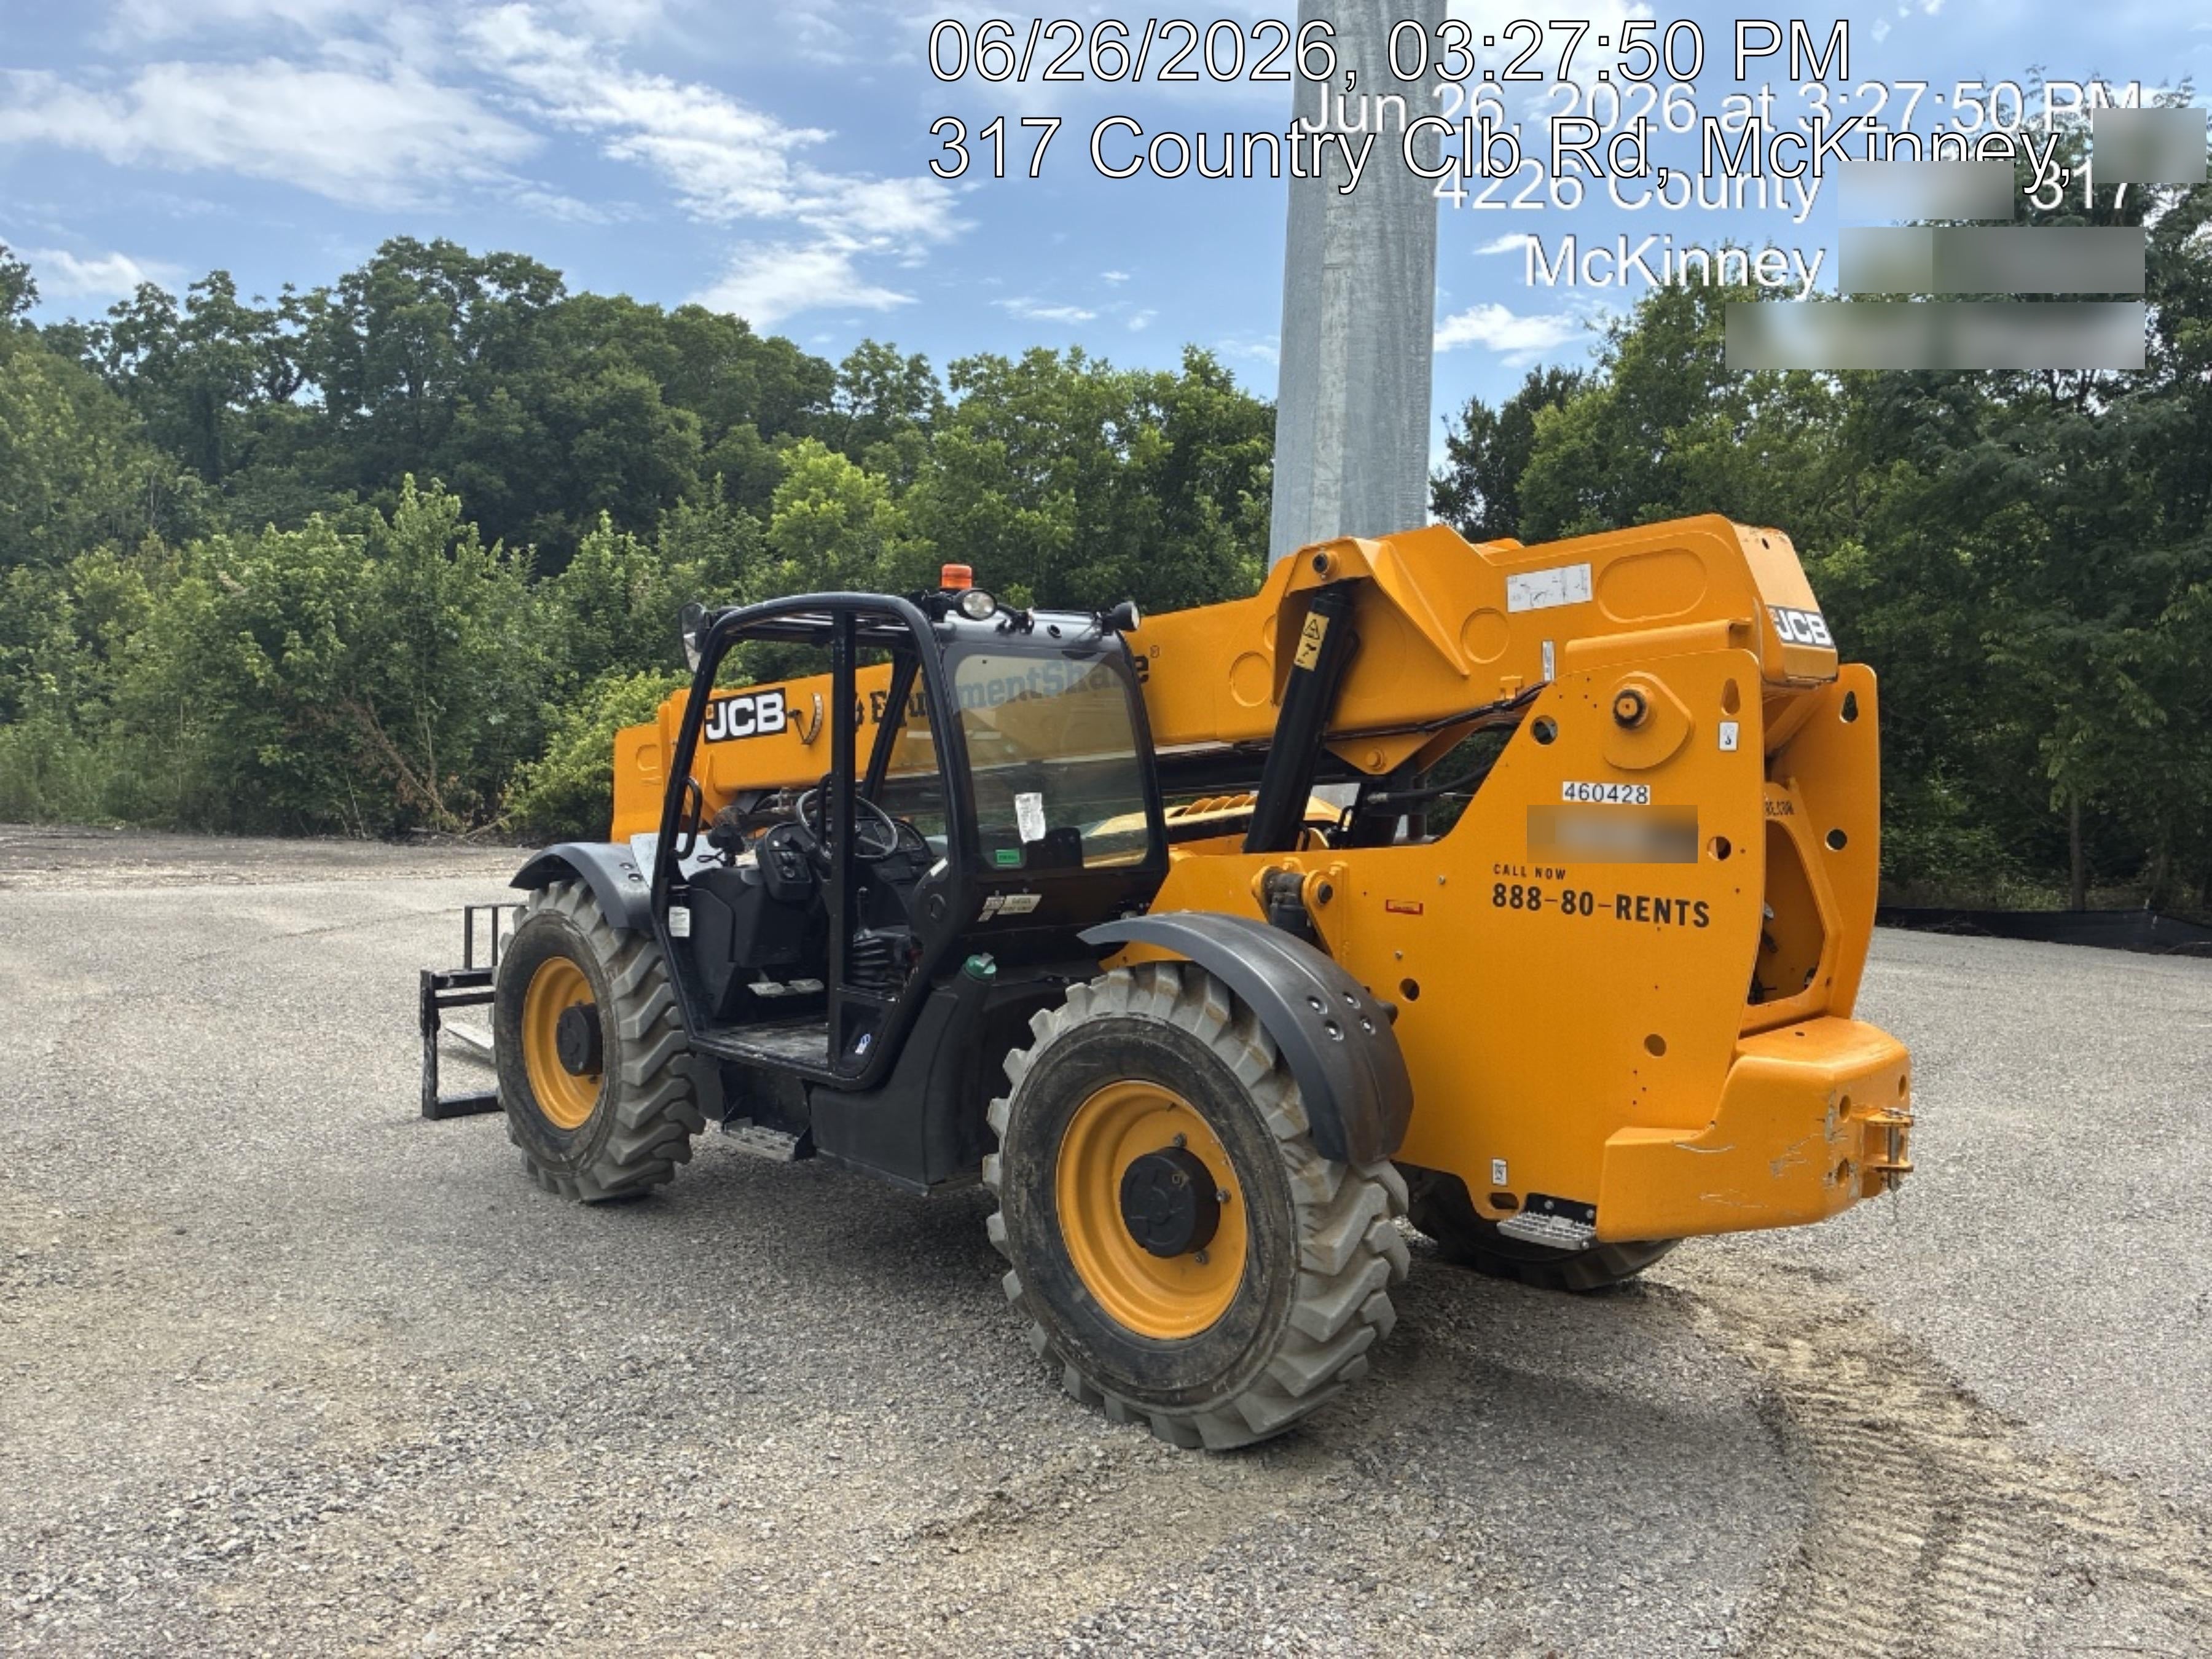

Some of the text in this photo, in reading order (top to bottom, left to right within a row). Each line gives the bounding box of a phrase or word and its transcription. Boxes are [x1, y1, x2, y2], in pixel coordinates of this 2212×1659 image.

[1773, 608, 1832, 645] JCB
[705, 692, 785, 740] JCB
[1564, 783, 1649, 804] 460428
[1494, 864, 1566, 880] CALL NOW
[1493, 883, 1710, 928] 888-80-RENTS
